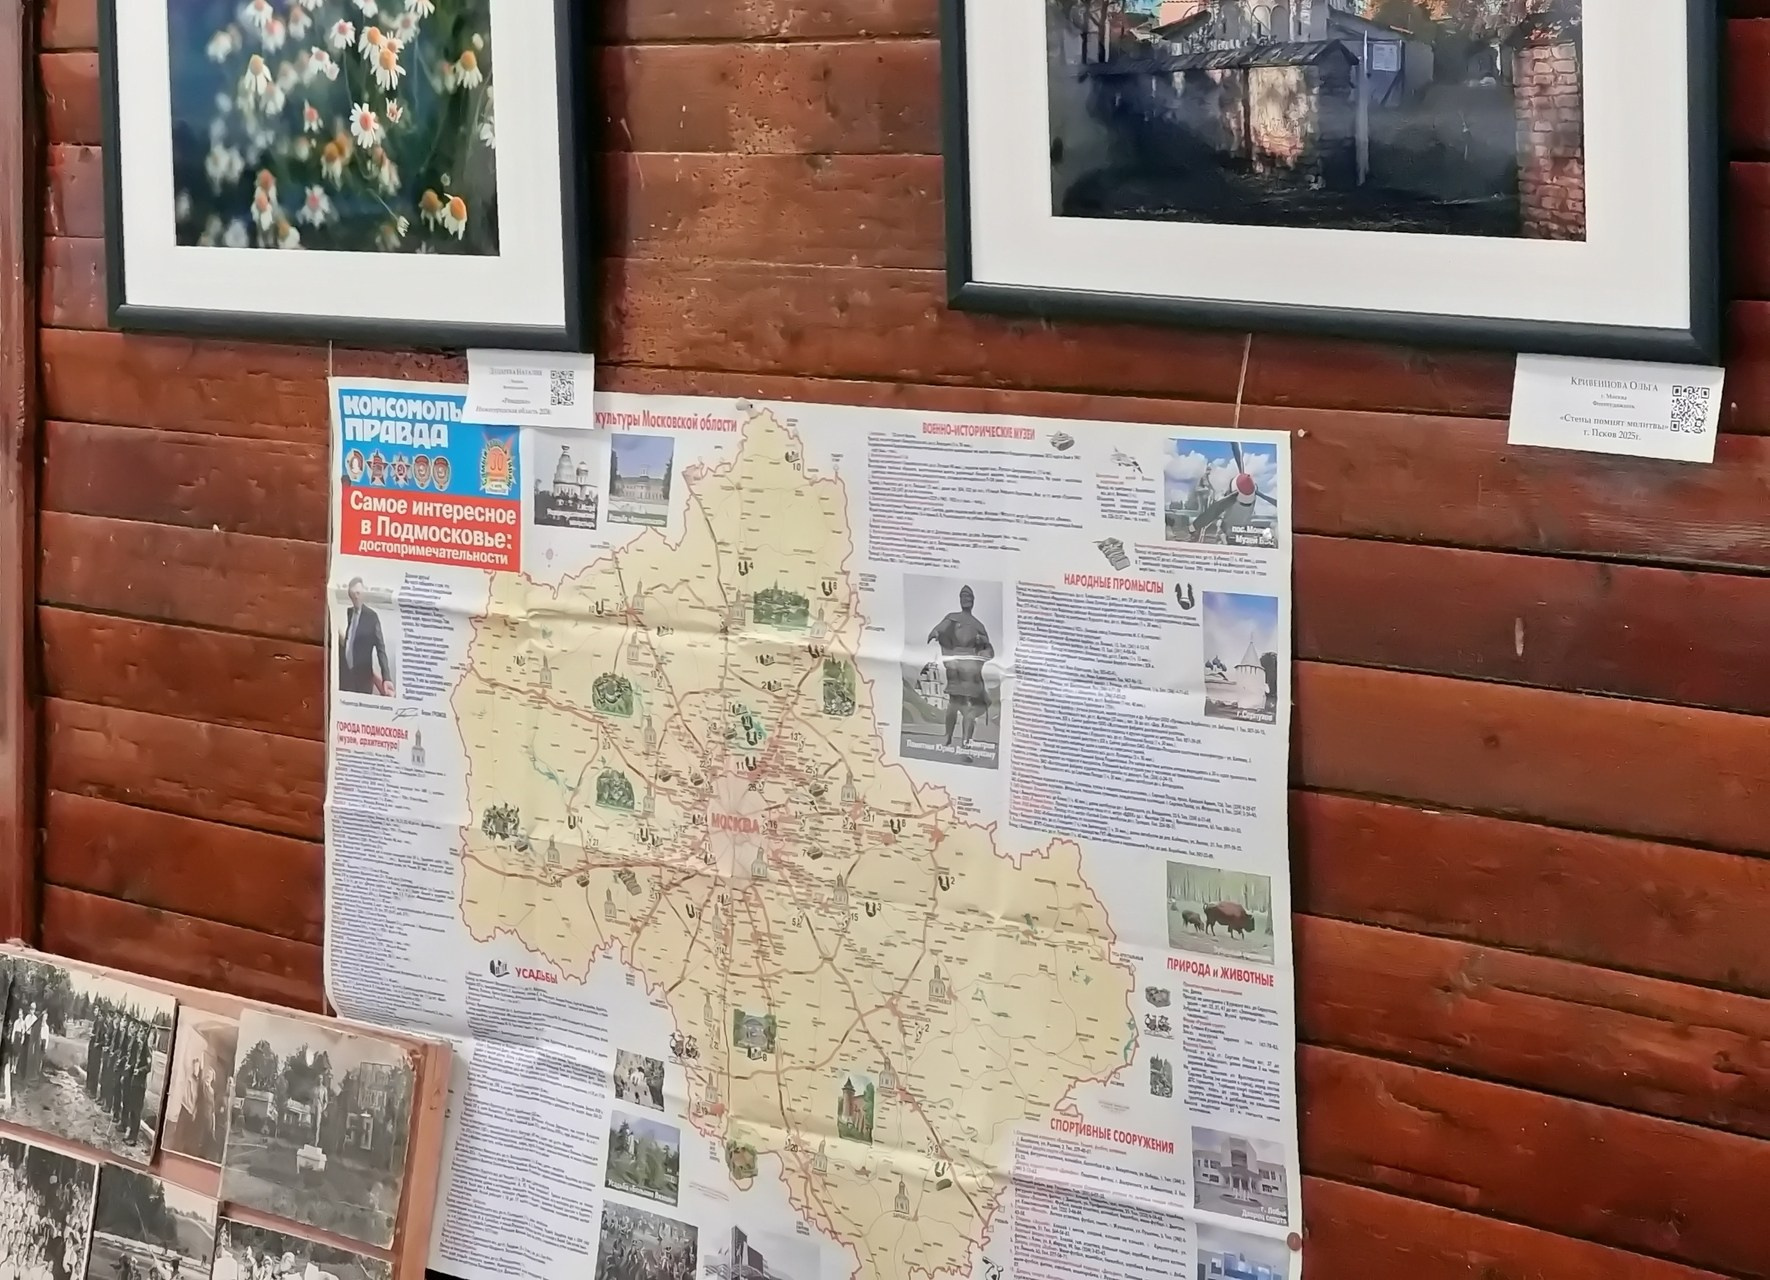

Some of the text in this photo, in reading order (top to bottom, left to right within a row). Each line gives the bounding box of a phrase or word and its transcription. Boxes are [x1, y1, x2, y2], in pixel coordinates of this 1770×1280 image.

[642, 410, 699, 430] Московской
[699, 413, 738, 432] области
[922, 422, 1036, 440] ВОЕННО-ИСТОРИЧЕСКИЕ МУЗЕИ
[344, 417, 449, 450] ПРАВДА
[1591, 428, 1617, 438] Псков
[792, 463, 801, 471] 10
[350, 490, 407, 515] Самое
[412, 499, 517, 525] интересное
[361, 516, 513, 550] в Подмосковье:
[359, 539, 509, 565] достопримечательности
[1063, 573, 1165, 594] НАРОДНЫЕ ПРОМЫСЛЫ
[336, 720, 409, 740] ГОРОДА ПОДМОСКОВЬЯ
[711, 812, 760, 834] МОСКВА
[515, 967, 558, 984] УСАДЬБЫ
[1167, 957, 1275, 987] ПРИРОДА и ЖИВОТНЫЕ
[1050, 1118, 1175, 1154] СПОРТИВНЫЕ СООРУЖЕНИЯ
